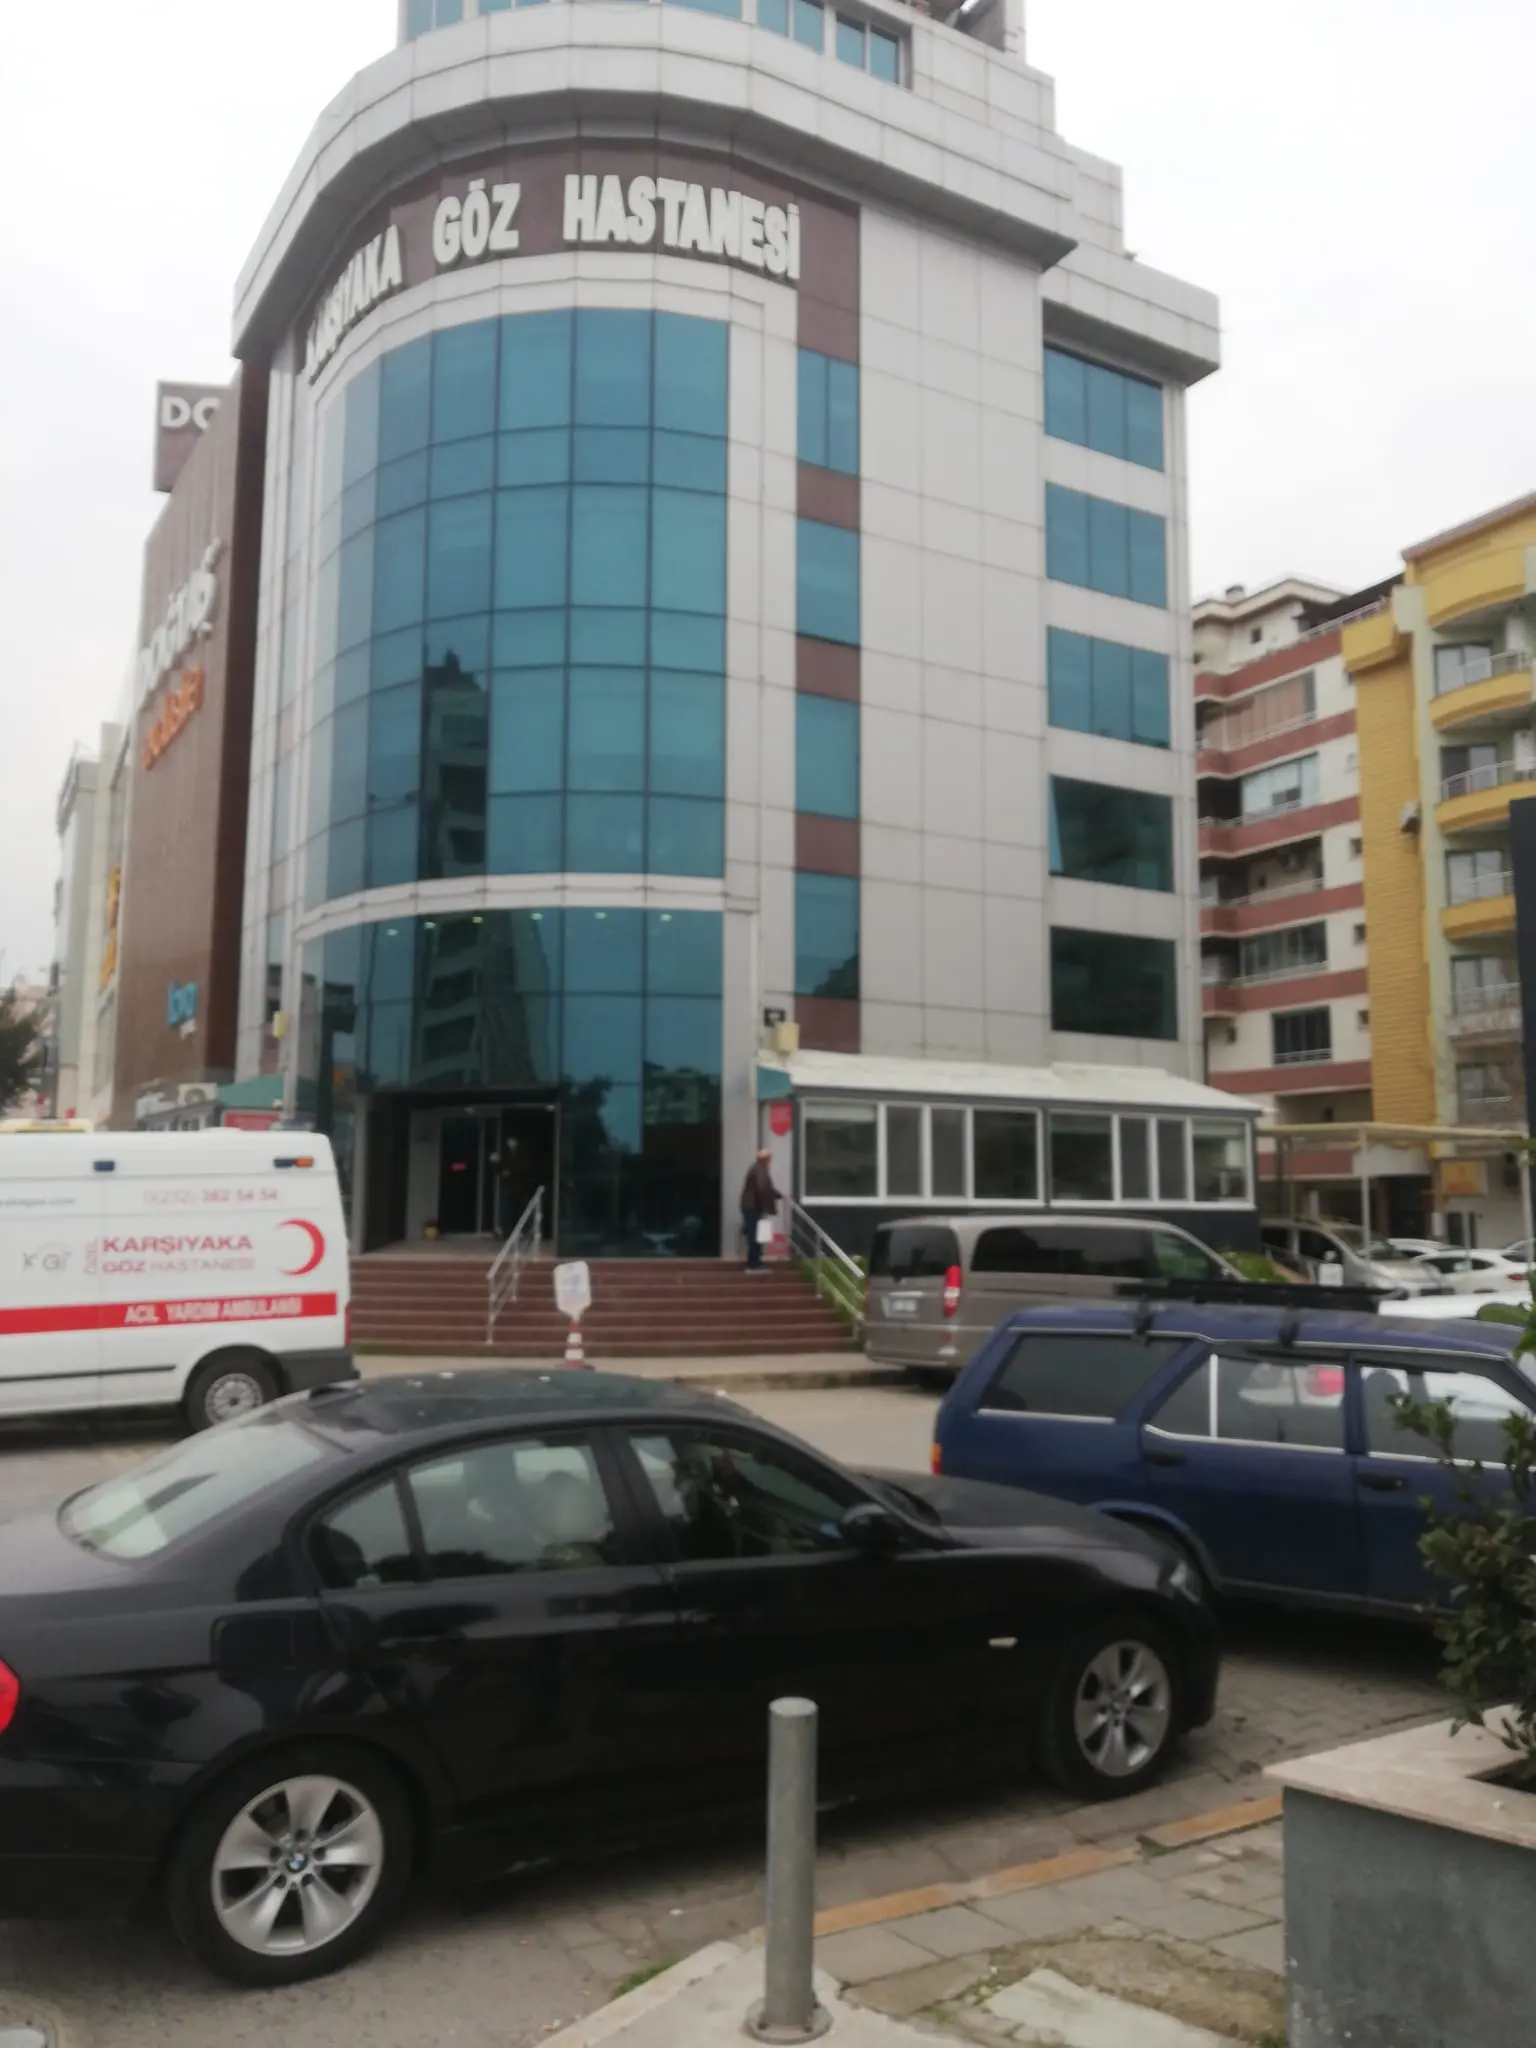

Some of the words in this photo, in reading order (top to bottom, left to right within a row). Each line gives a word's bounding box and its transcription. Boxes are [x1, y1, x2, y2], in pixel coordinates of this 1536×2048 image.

[432, 179, 521, 265] GÖZ
[562, 174, 801, 281] HASTANESİ
[102, 1235, 253, 1254] KARŞIYAKA
